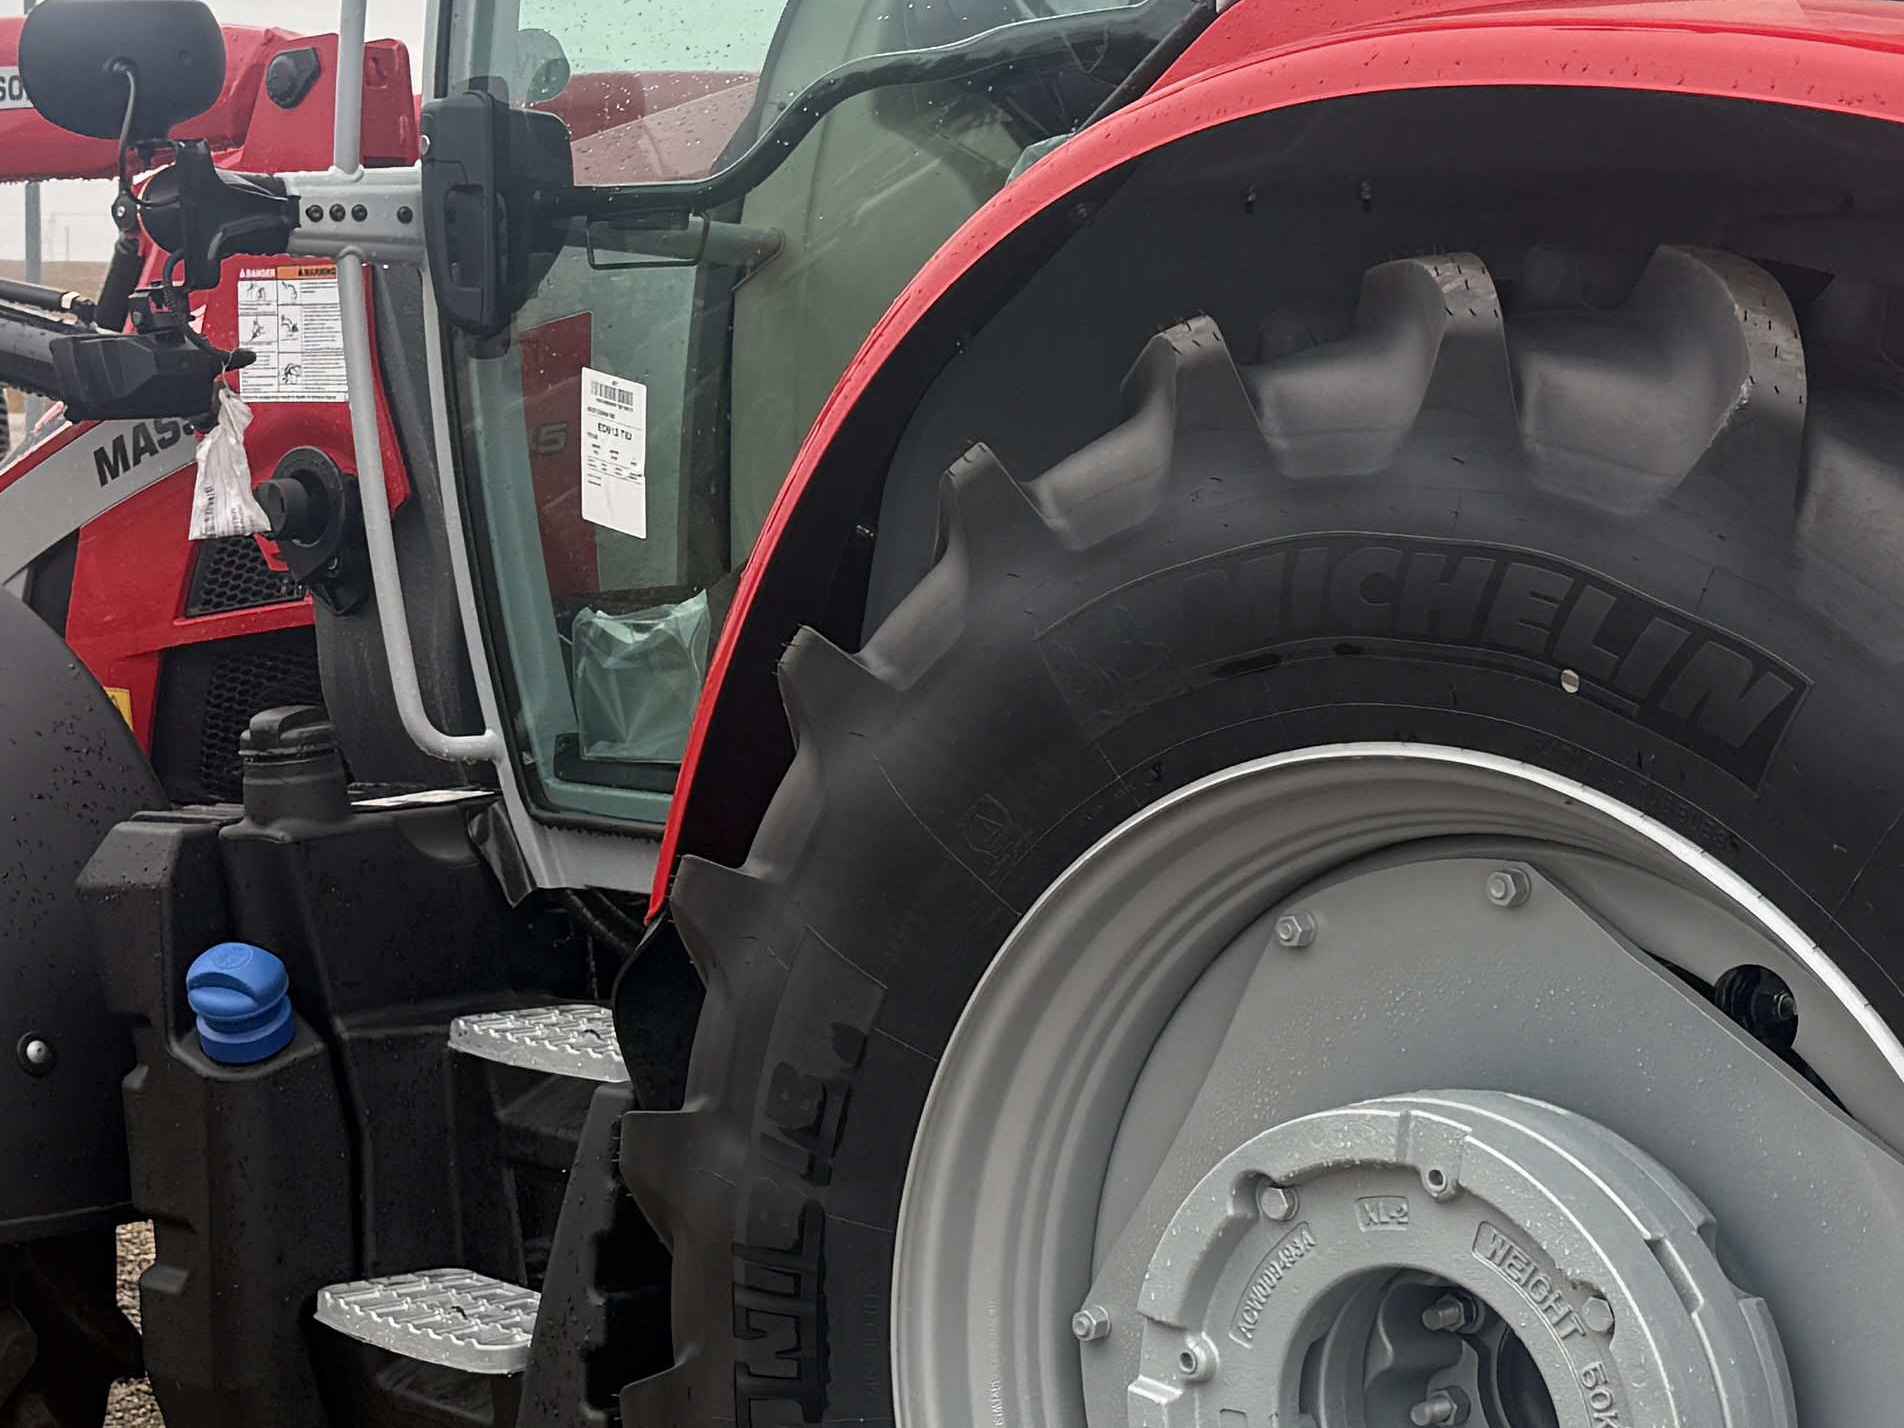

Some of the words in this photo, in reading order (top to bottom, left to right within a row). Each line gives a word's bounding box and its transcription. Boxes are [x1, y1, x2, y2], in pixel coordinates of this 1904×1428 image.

[93, 418, 194, 487] MAS
[1182, 545, 1796, 750] MICHELIN
[1485, 1230, 1587, 1340] WEIGHT
